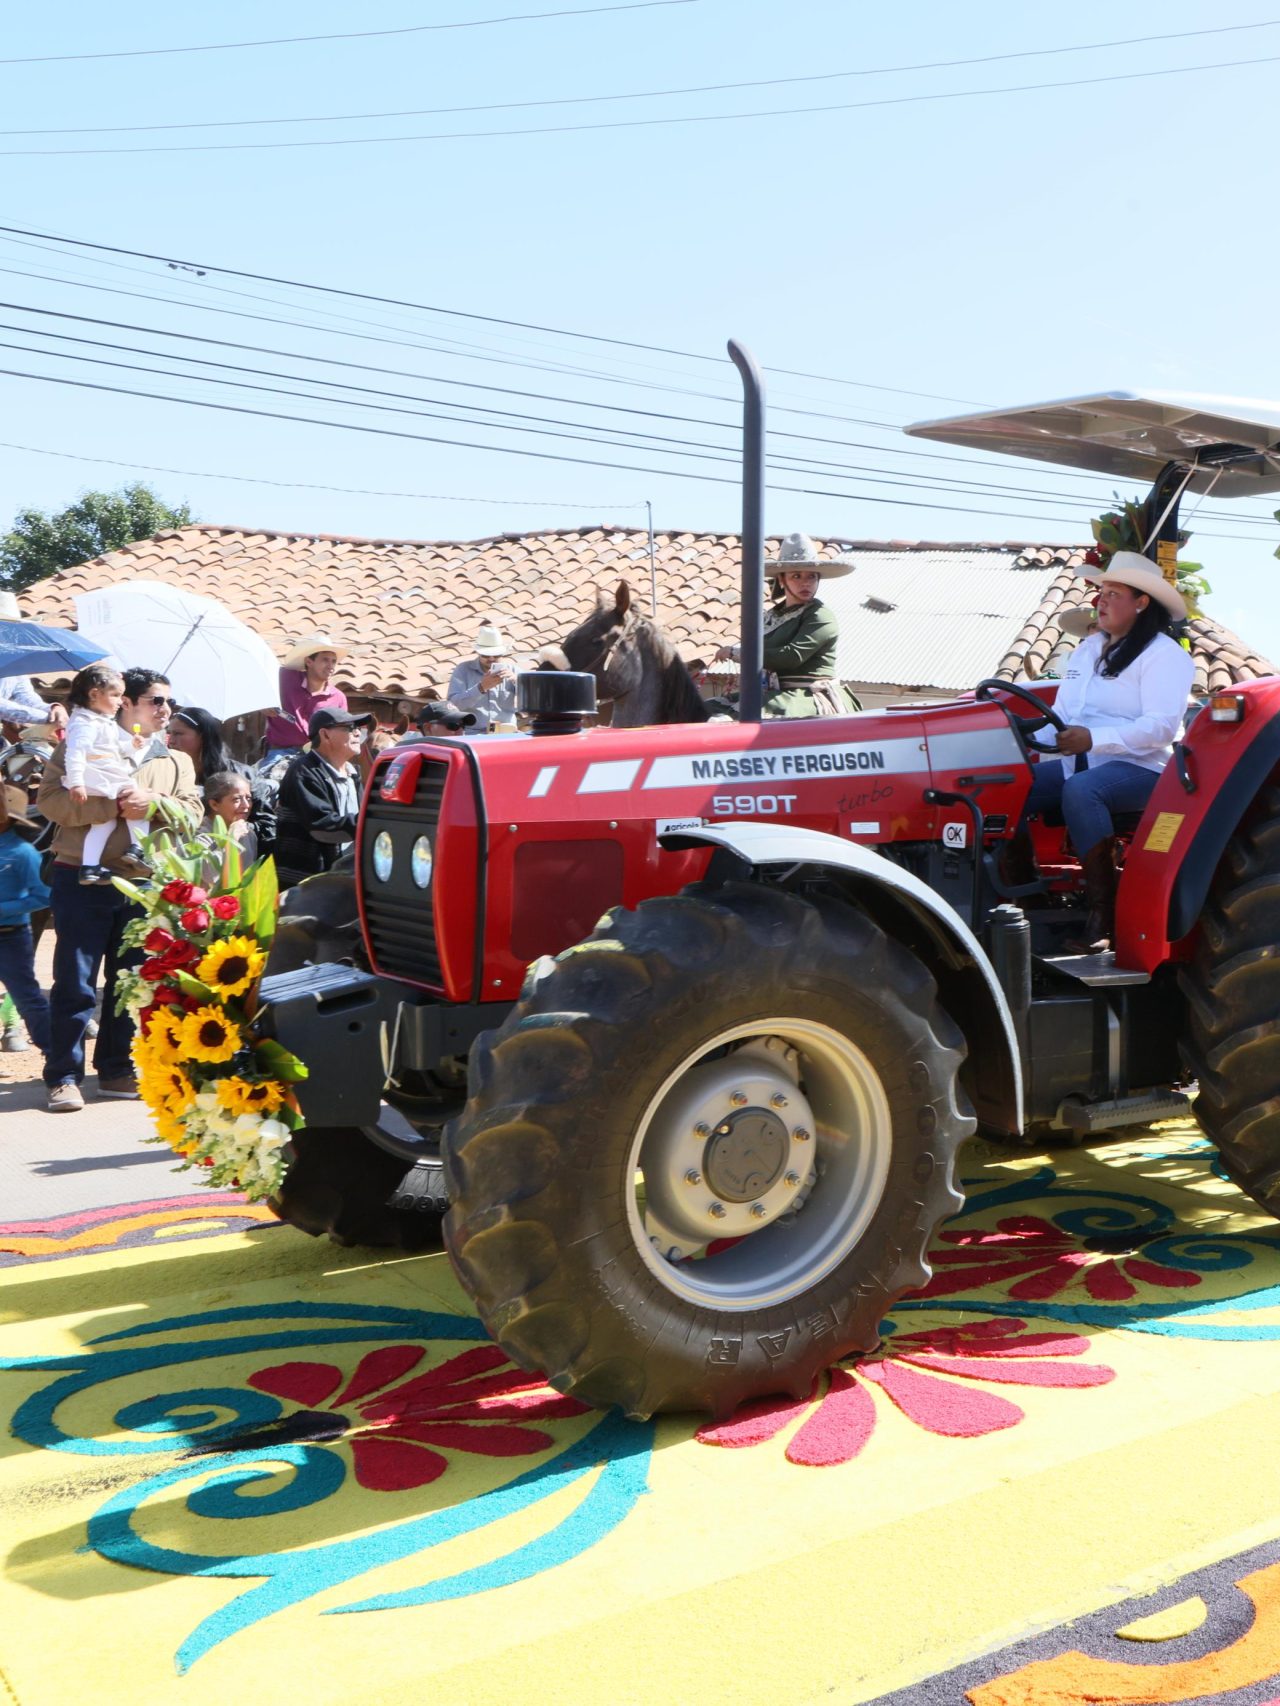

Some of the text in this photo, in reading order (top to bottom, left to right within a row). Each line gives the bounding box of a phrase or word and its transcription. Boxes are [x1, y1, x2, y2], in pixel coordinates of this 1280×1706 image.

[692, 751, 885, 779] MASSEY FERGUSON
[713, 795, 797, 815] 590T
[838, 780, 893, 813] turbo
[946, 826, 963, 842] OK
